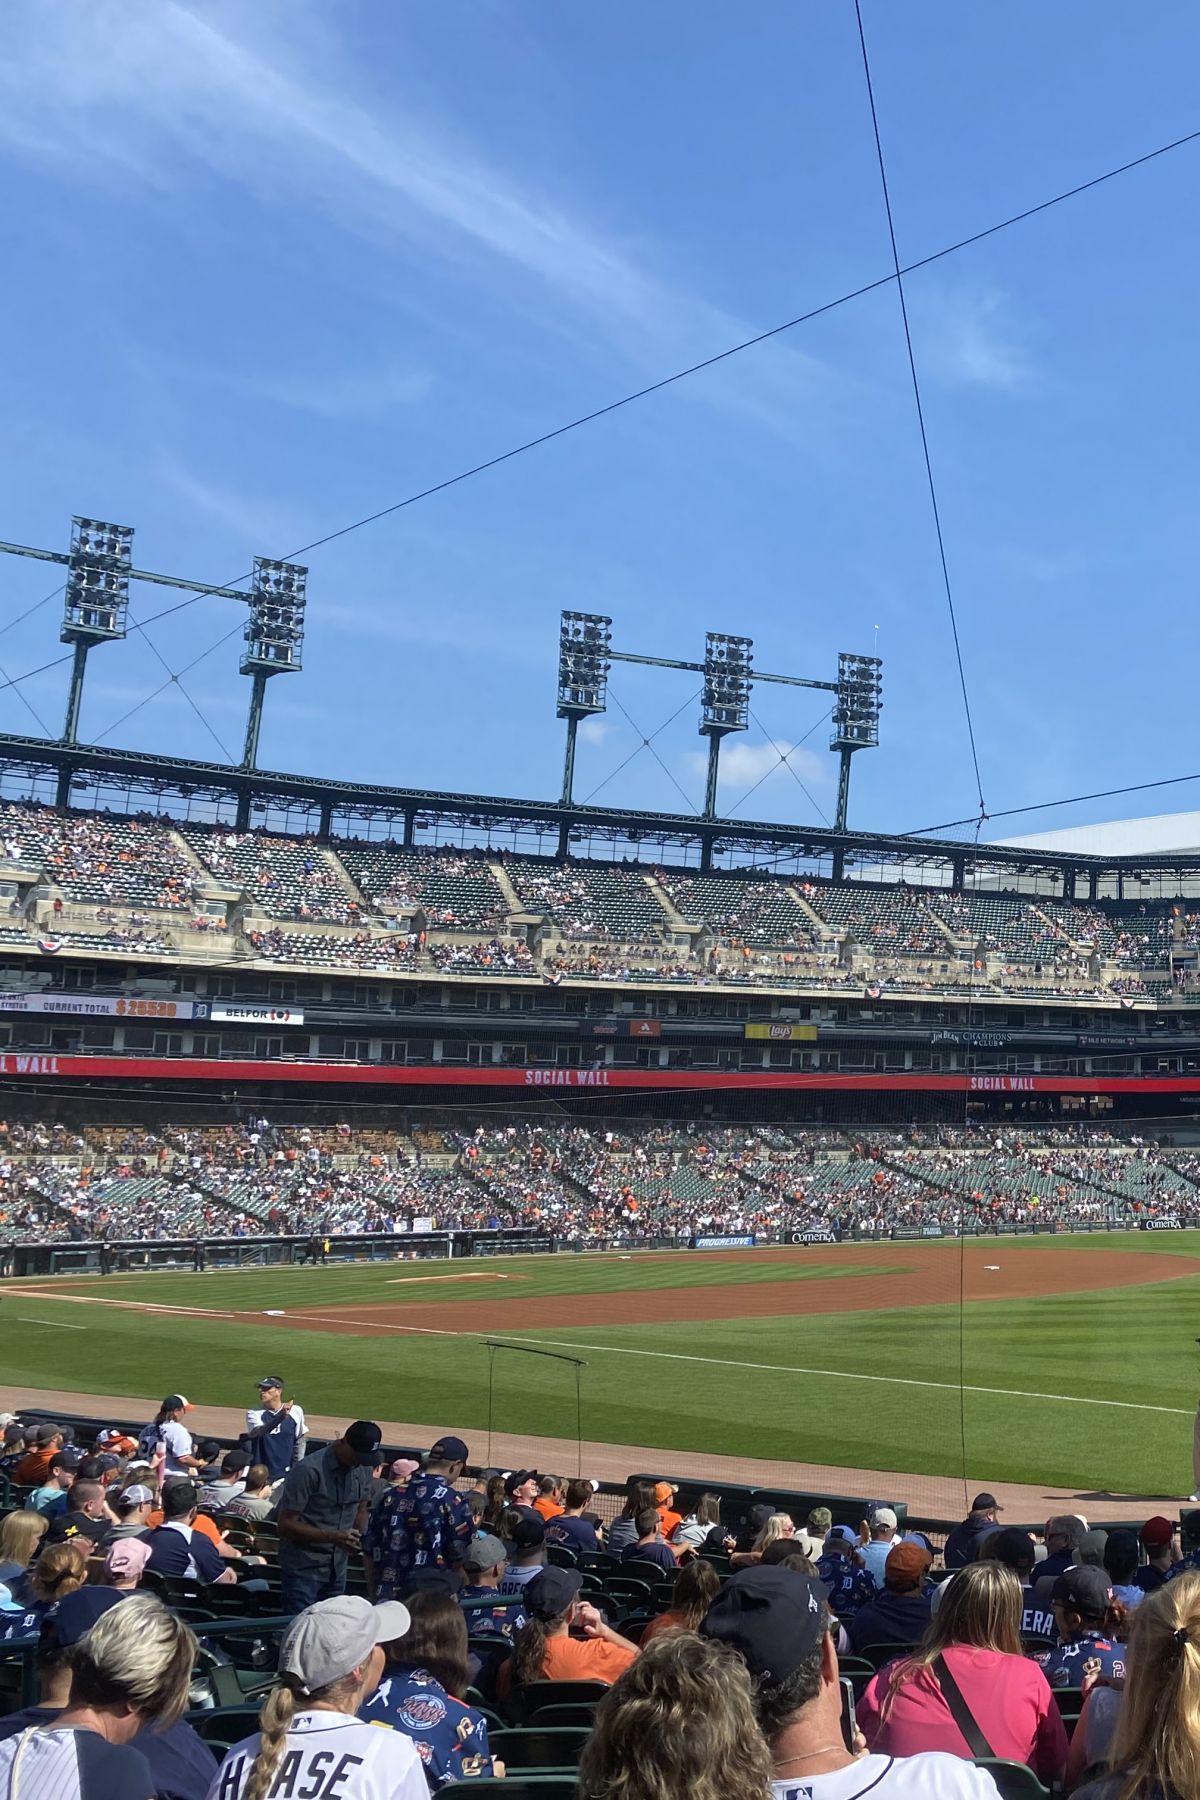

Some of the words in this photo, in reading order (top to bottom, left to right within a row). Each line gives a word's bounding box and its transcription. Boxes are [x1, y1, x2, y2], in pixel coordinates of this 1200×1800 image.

[43, 1002, 83, 1013] CURRENT
[85, 1004, 110, 1014] TOTAL
[226, 1008, 268, 1019] BELFOR
[931, 1031, 943, 1044] JIM
[944, 1031, 960, 1044] BEAM
[963, 1032, 1012, 1042] CHAMPIONS
[16, 1056, 60, 1074] WALL
[525, 1070, 572, 1085] SOCIAL
[577, 1071, 610, 1085] WALL
[971, 1077, 1006, 1090] SOCIAL
[1010, 1077, 1035, 1090] WALL
[697, 1236, 751, 1247] PROGRESSIVE
[218, 1750, 364, 1800] HASE
